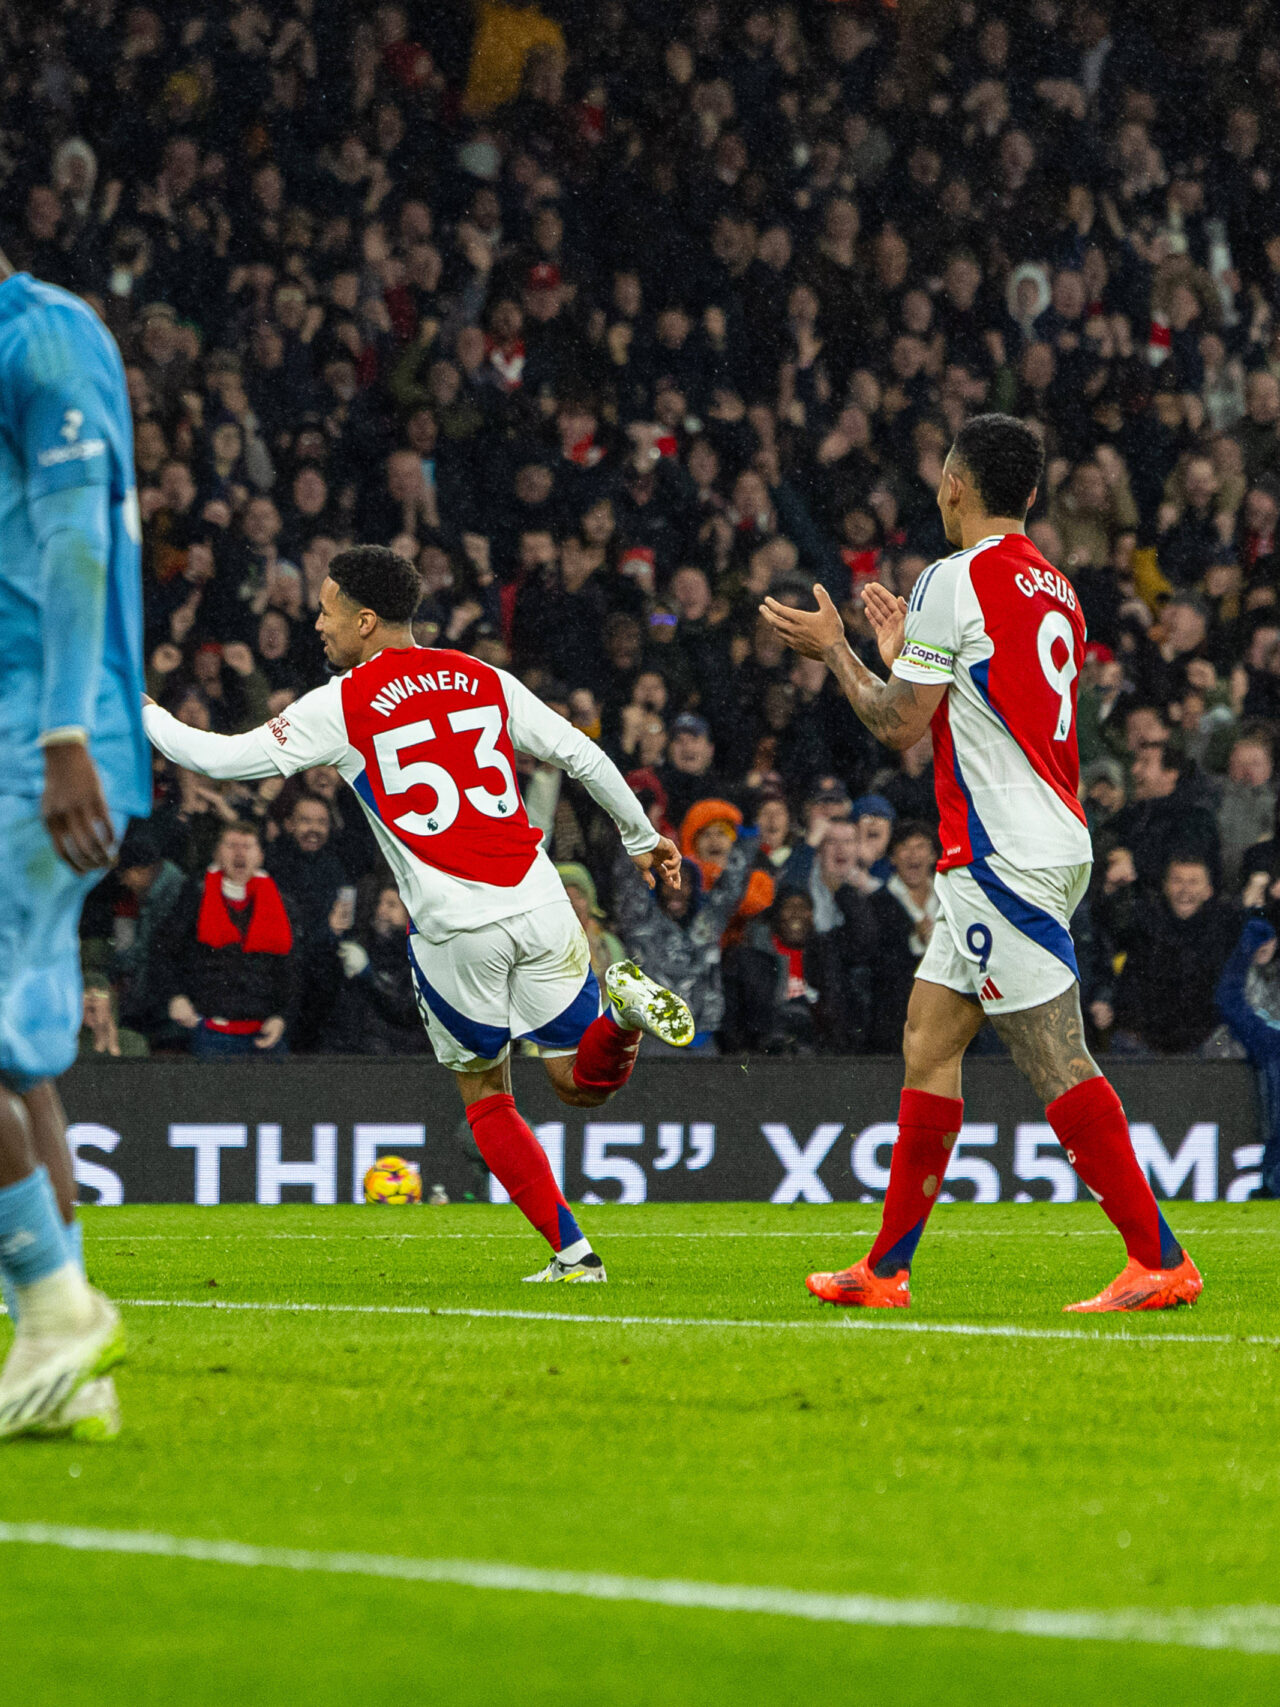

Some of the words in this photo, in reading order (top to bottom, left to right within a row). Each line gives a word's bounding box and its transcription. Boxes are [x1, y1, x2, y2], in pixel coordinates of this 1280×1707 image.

[1014, 566, 1077, 612] G.JESUS
[370, 670, 479, 718] NWANERI
[1036, 610, 1078, 742] 9
[372, 704, 520, 837] 53
[966, 922, 993, 974] 9
